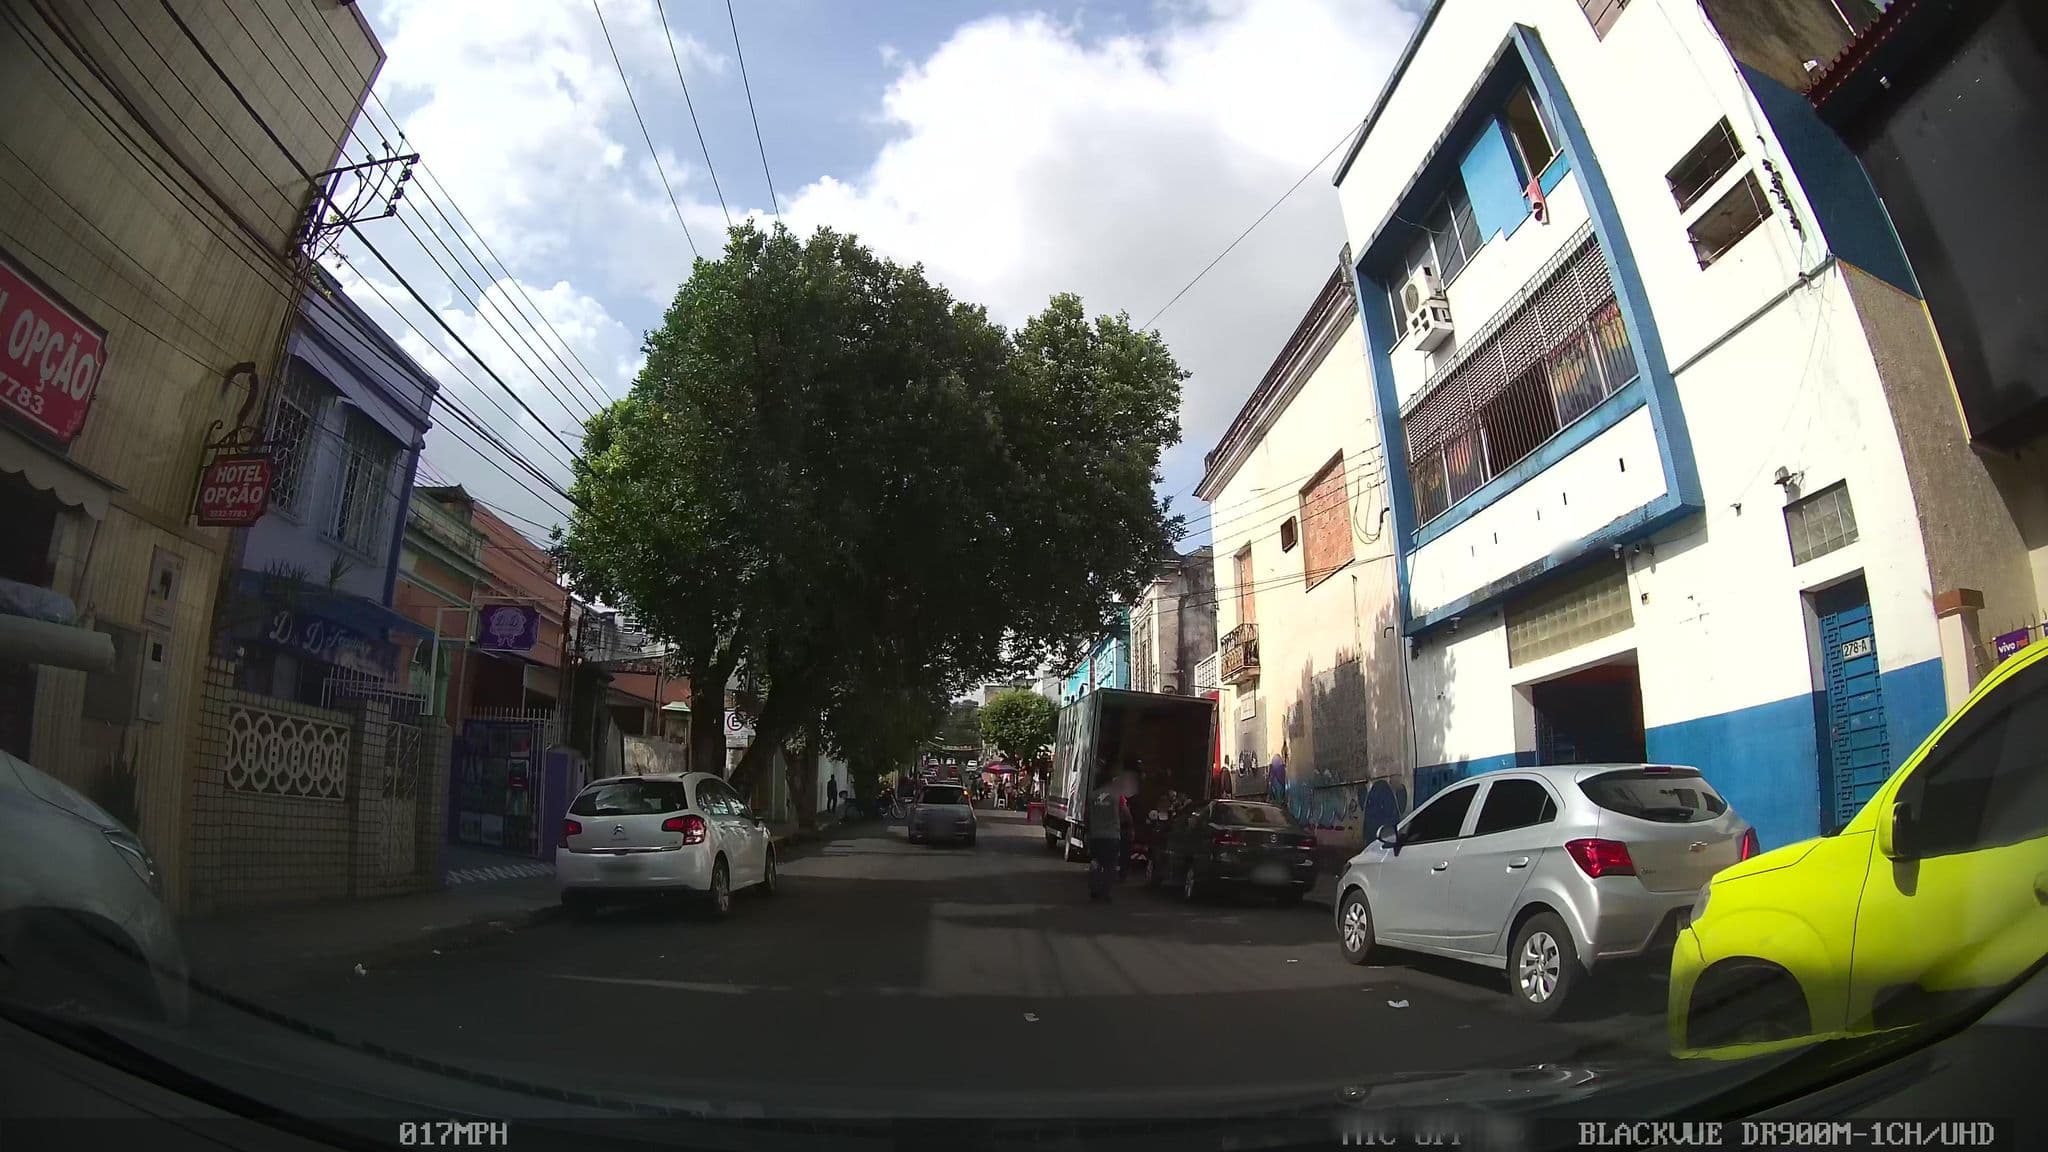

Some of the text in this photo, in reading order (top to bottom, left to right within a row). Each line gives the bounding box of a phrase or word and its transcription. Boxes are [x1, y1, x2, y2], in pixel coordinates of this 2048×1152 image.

[8, 309, 95, 400] OPÇÃO
[215, 465, 262, 483] HOTEL
[204, 483, 263, 508] OPÇÃO
[1843, 640, 1868, 656] 278-A
[1998, 642, 2016, 653] vivo
